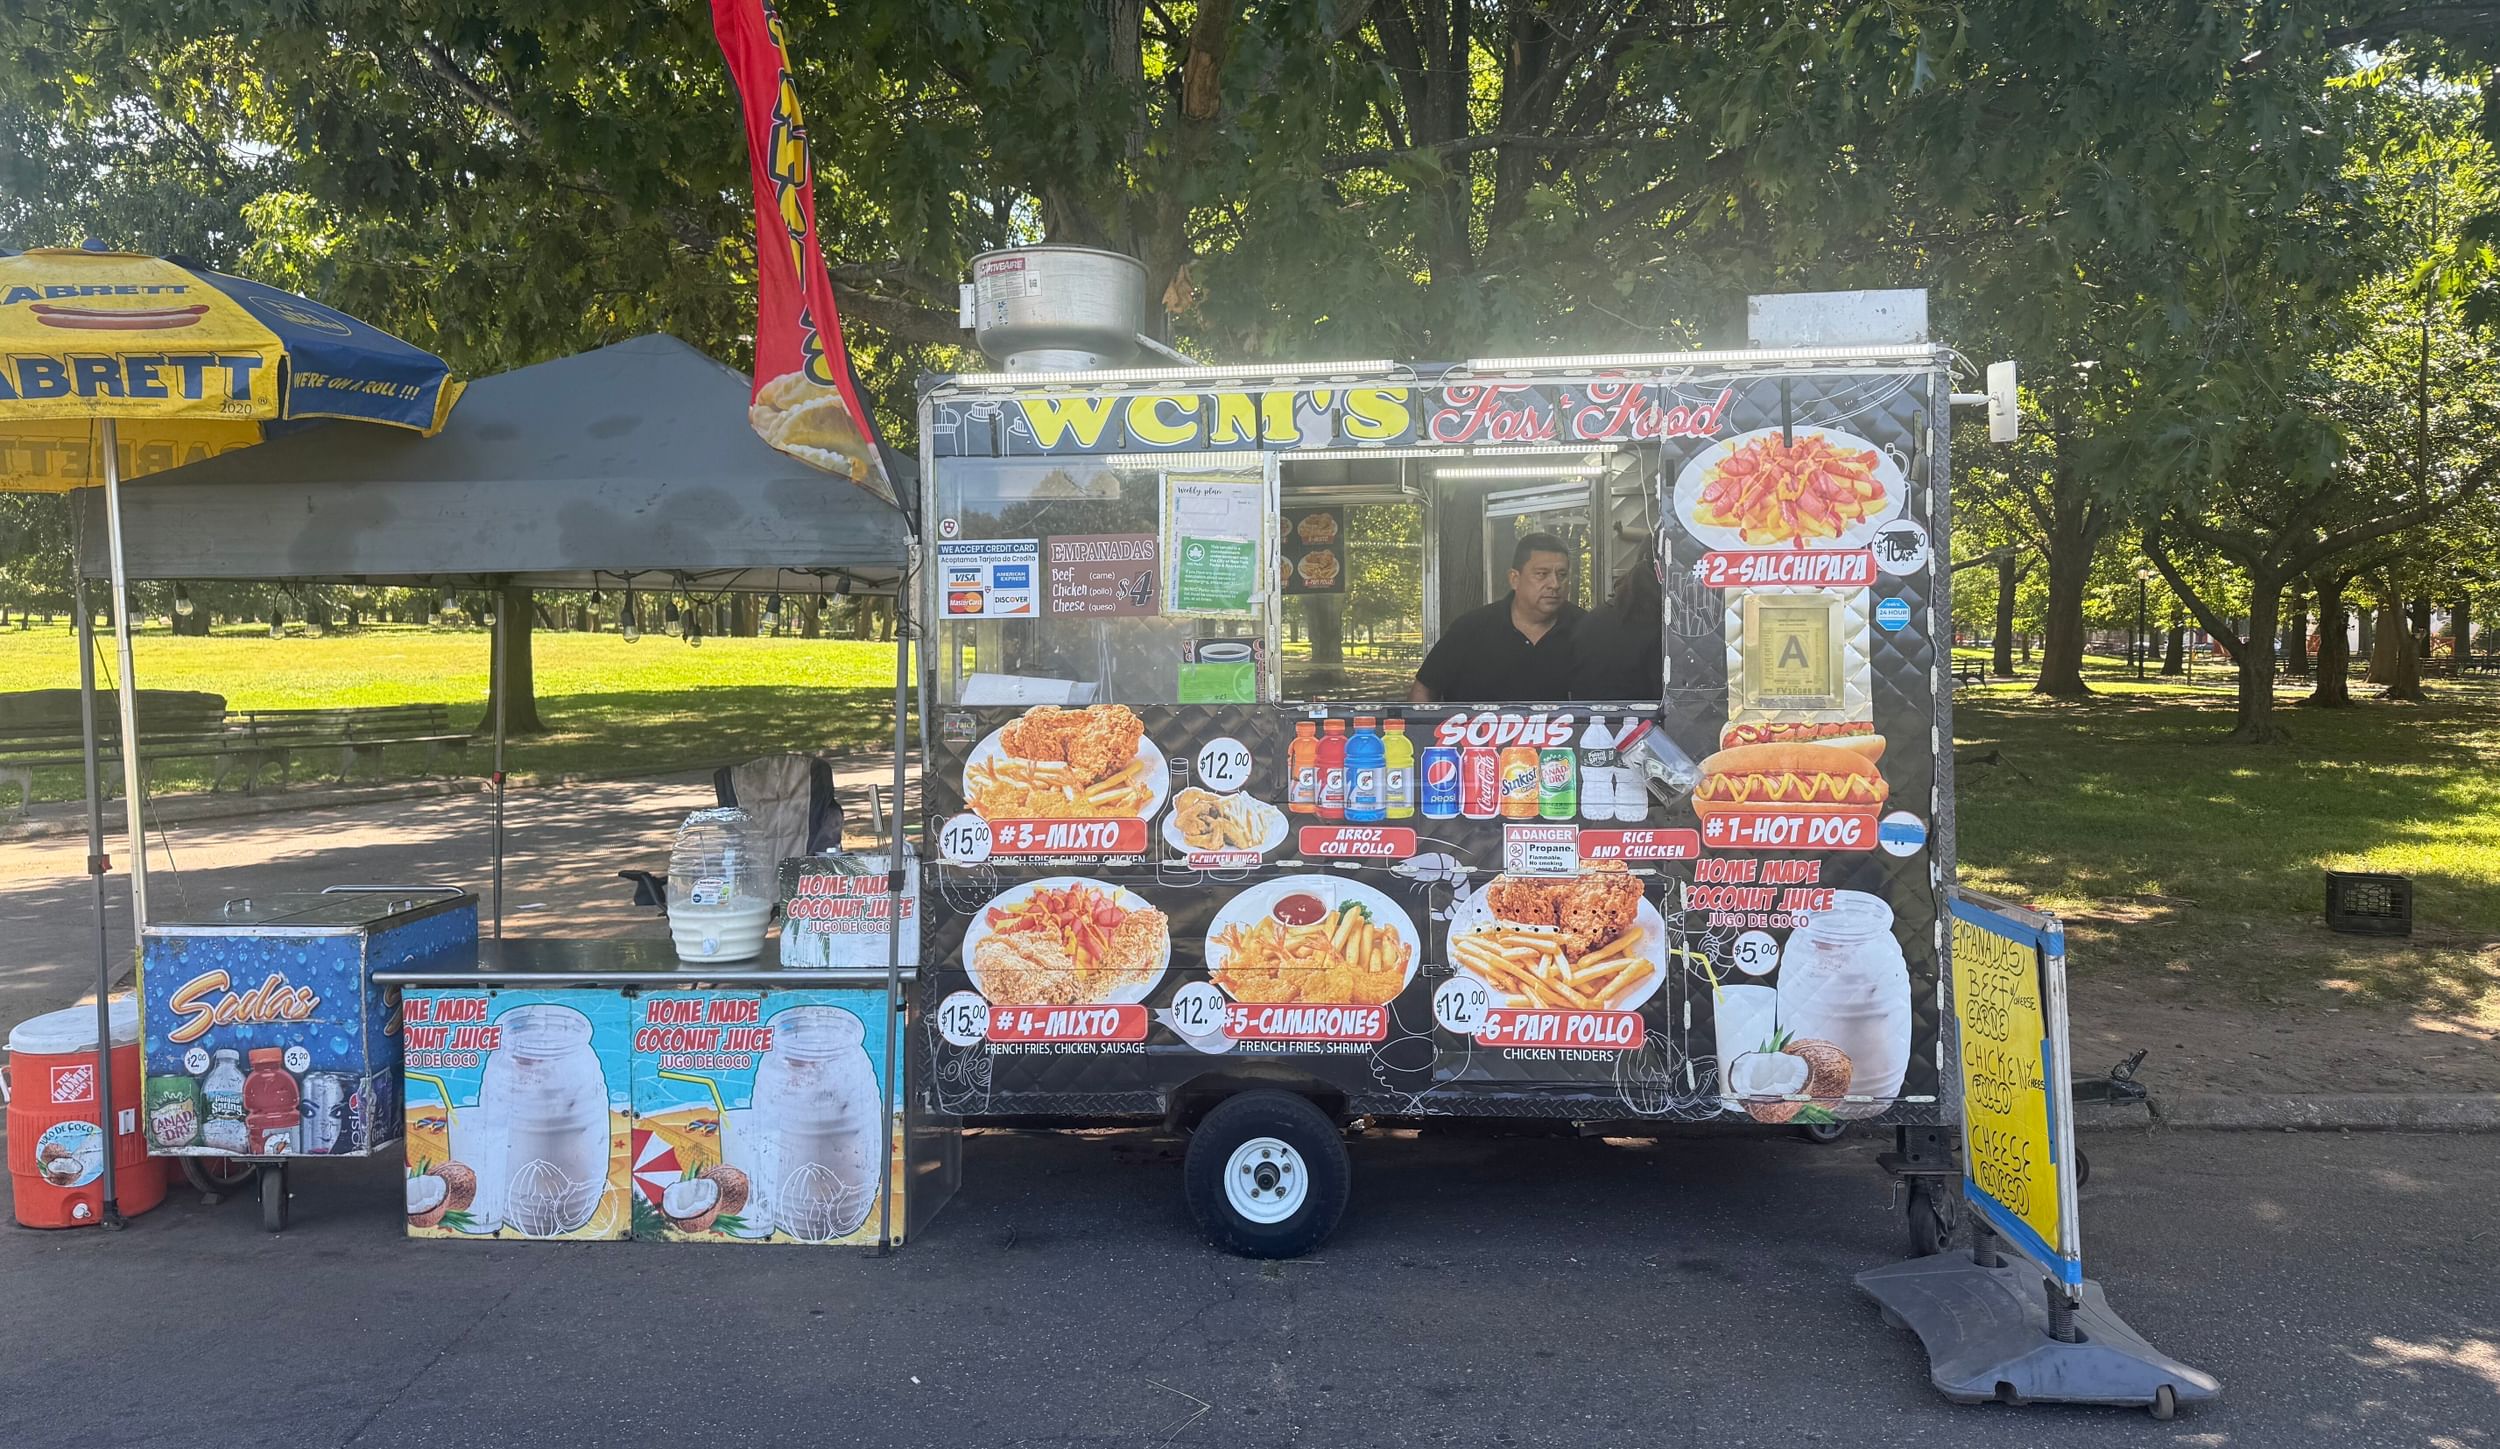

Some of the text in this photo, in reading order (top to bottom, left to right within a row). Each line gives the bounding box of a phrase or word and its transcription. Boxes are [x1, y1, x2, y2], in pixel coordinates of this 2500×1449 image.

[294, 372, 420, 400] WE'RE ON A ROLL !!!
[220, 403, 252, 415] 2020
[1015, 386, 1410, 449] WCM'S
[1573, 378, 1733, 442] Food
[1177, 486, 1202, 497] Weekly
[941, 543, 1035, 554] WE ACCEPT CREDIT CARD
[1051, 540, 1155, 563] EMPANADAS
[941, 556, 978, 564] Aceptamos
[955, 573, 976, 582] VISA
[1052, 567, 1075, 582] Beef
[1052, 581, 1113, 597] Chicken (pollo)
[1116, 569, 1154, 607] $4
[1052, 599, 1116, 613] Cheese (queso)
[1778, 634, 1809, 668] A
[1437, 712, 1574, 746] SODAS
[1199, 751, 1250, 780] $12.00
[1502, 767, 1537, 796] Sunkist
[1549, 774, 1566, 785] DRY
[1430, 794, 1456, 805] pepsi
[1336, 829, 1383, 841] ARROZ
[1522, 829, 1573, 840] DANGER
[1622, 832, 1654, 844] RICE
[1808, 816, 1861, 845] DOG
[944, 826, 989, 855] $15.00
[1319, 842, 1395, 855] CON POLLO
[1529, 844, 1574, 853] Propane.
[1592, 845, 1685, 858] AND CHICKEN
[1695, 858, 1821, 885] HOME MADE
[798, 875, 889, 895] HOME MAD
[1685, 886, 1835, 912] COCONUT JUICE
[786, 897, 915, 920] COCONUT JUIE
[807, 921, 892, 934] JUGO DE COCO
[1706, 913, 1809, 928] JUGO DE COCO
[1734, 941, 1778, 965] $5.00
[1952, 919, 2022, 970] EMPANADAS
[1967, 968, 2009, 1008] BEEF
[168, 969, 320, 1043] Sodas
[434, 997, 489, 1023] MADE
[646, 999, 761, 1025] HOME MADE
[1174, 995, 1224, 1025] $12.00
[450, 1024, 503, 1051] JUICE
[1565, 1015, 1635, 1045] POLLO
[634, 1026, 775, 1053] COCONUT JUICE
[1239, 1041, 1372, 1055] FRENCH FRIES, SHRIMP
[985, 1043, 1145, 1056] FRENCH FRIES, CHICKEN, SAUSAGE
[1503, 1048, 1614, 1062] CHICKEN TENDERS
[423, 1053, 442, 1068] DE
[443, 1053, 480, 1068] COCO
[658, 1054, 752, 1069] JUGO DE COCO
[54, 1067, 91, 1101] HOME
[56, 1072, 73, 1085] THE
[68, 1078, 91, 1101] DEPOT
[211, 1101, 243, 1115] Spring
[67, 1122, 94, 1133] COCO
[165, 1124, 191, 1141] DRY
[1972, 1124, 2032, 1182] CHEESE
